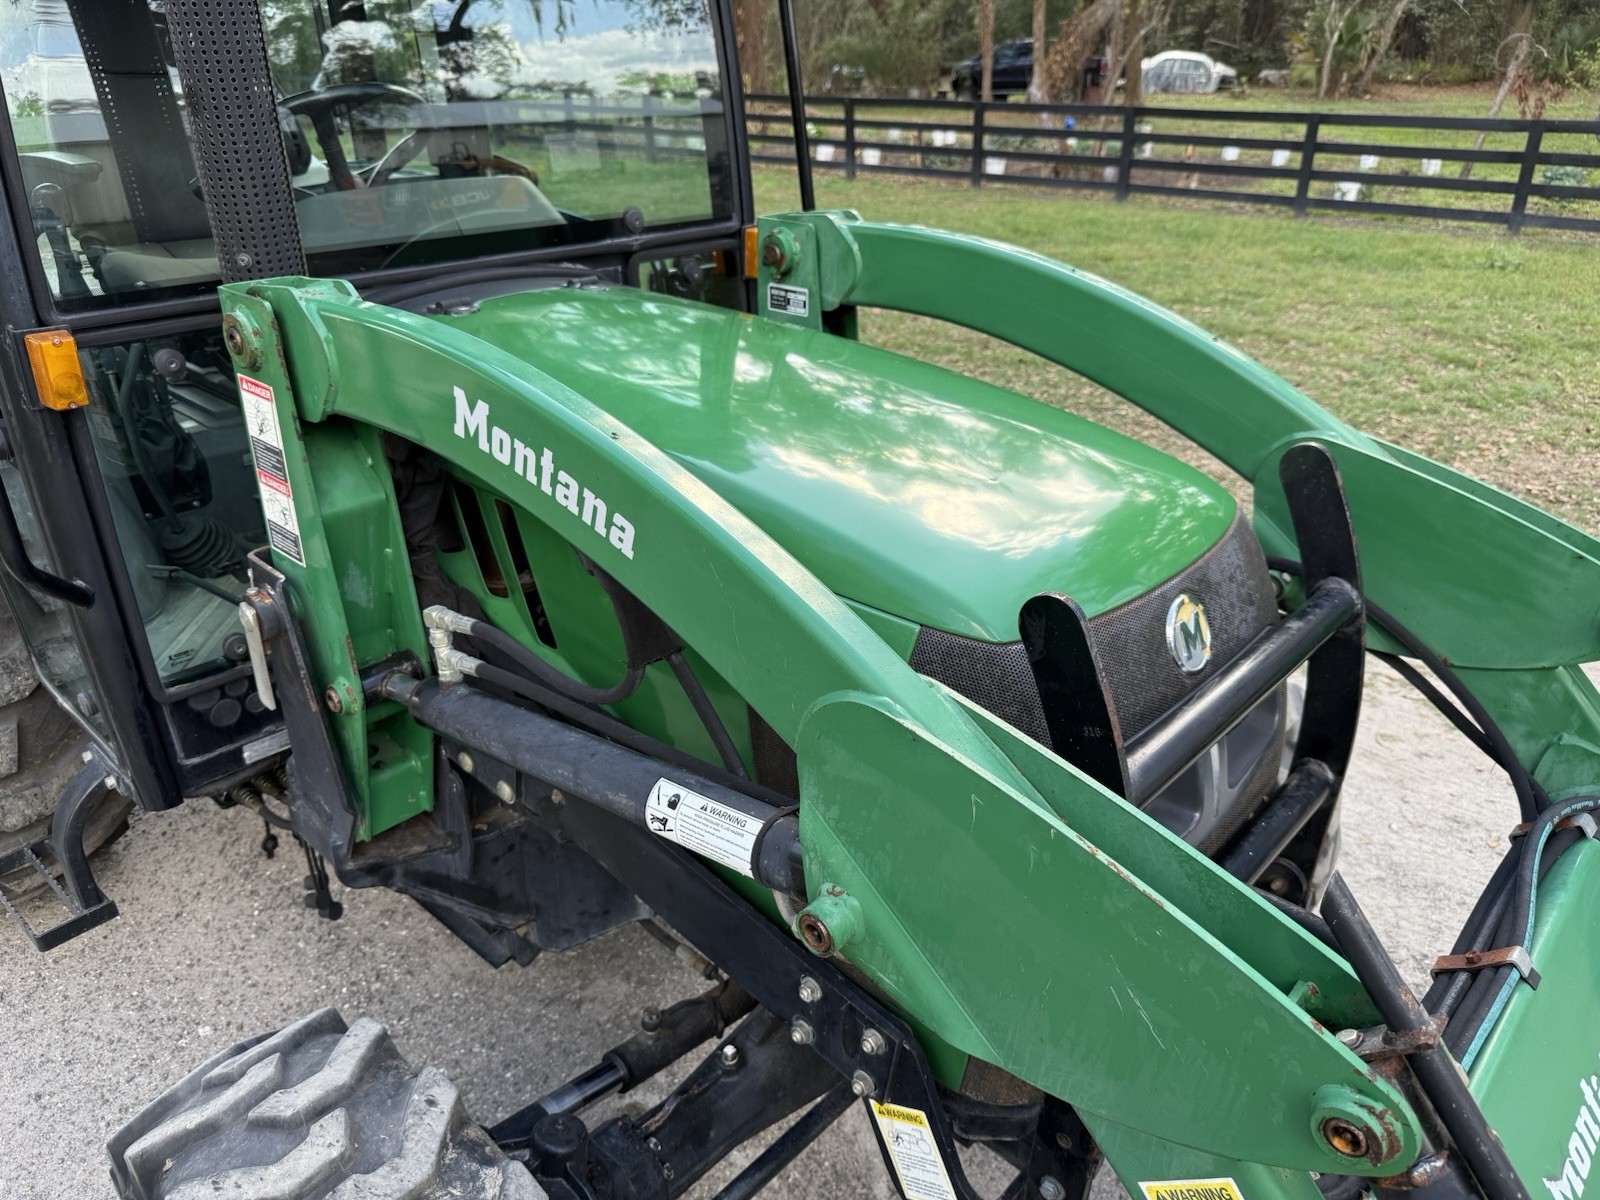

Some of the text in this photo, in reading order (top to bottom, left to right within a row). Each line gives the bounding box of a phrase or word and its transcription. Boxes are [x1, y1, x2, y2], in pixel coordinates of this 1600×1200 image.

[246, 381, 271, 400] DANGER
[453, 385, 635, 561] Montana
[709, 805, 748, 828] WARNING
[885, 1106, 923, 1126] WARNING
[1164, 1187, 1233, 1200] WARNING
